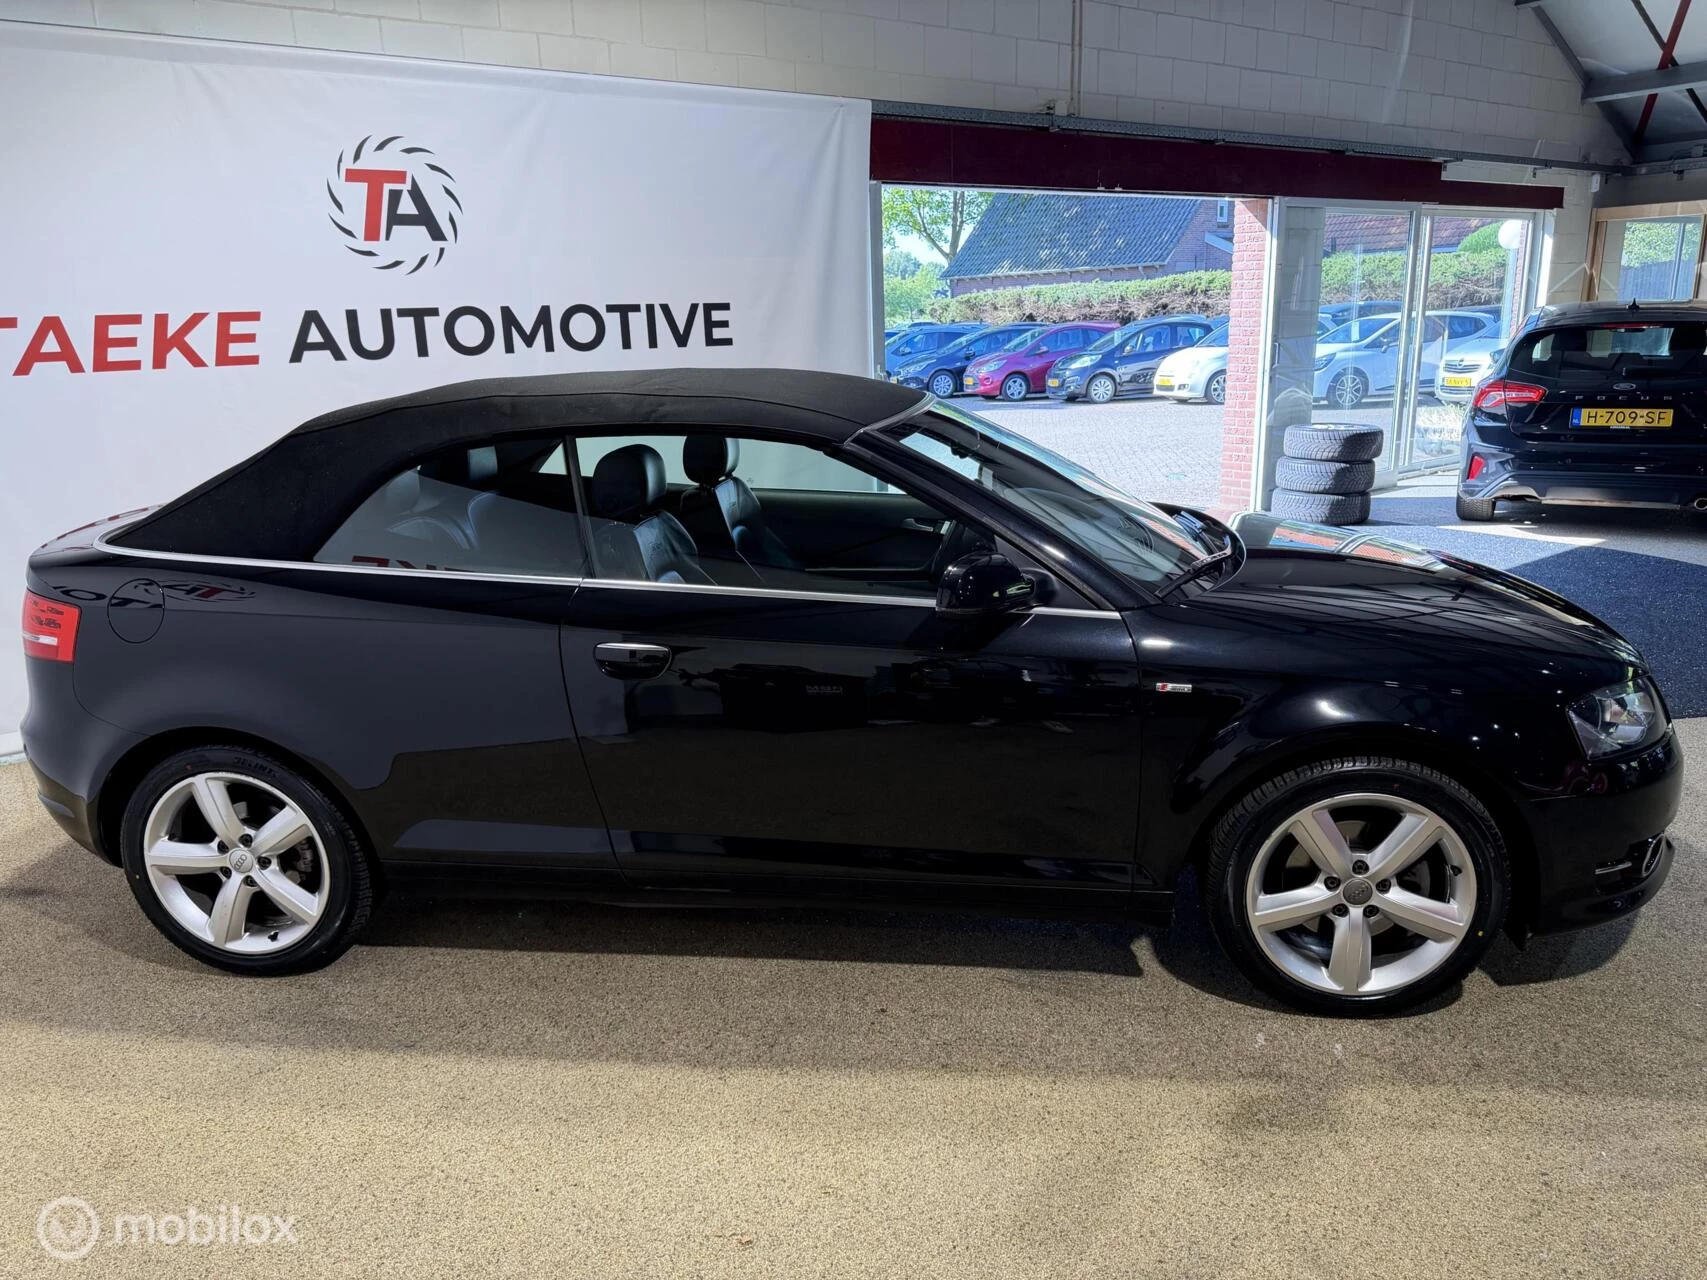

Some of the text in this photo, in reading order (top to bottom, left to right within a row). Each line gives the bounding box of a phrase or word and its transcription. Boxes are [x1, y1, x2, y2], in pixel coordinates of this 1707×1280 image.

[345, 168, 448, 241] TA
[289, 303, 733, 363] AUTOMOTIVE
[1586, 411, 1667, 424] H-709-SF
